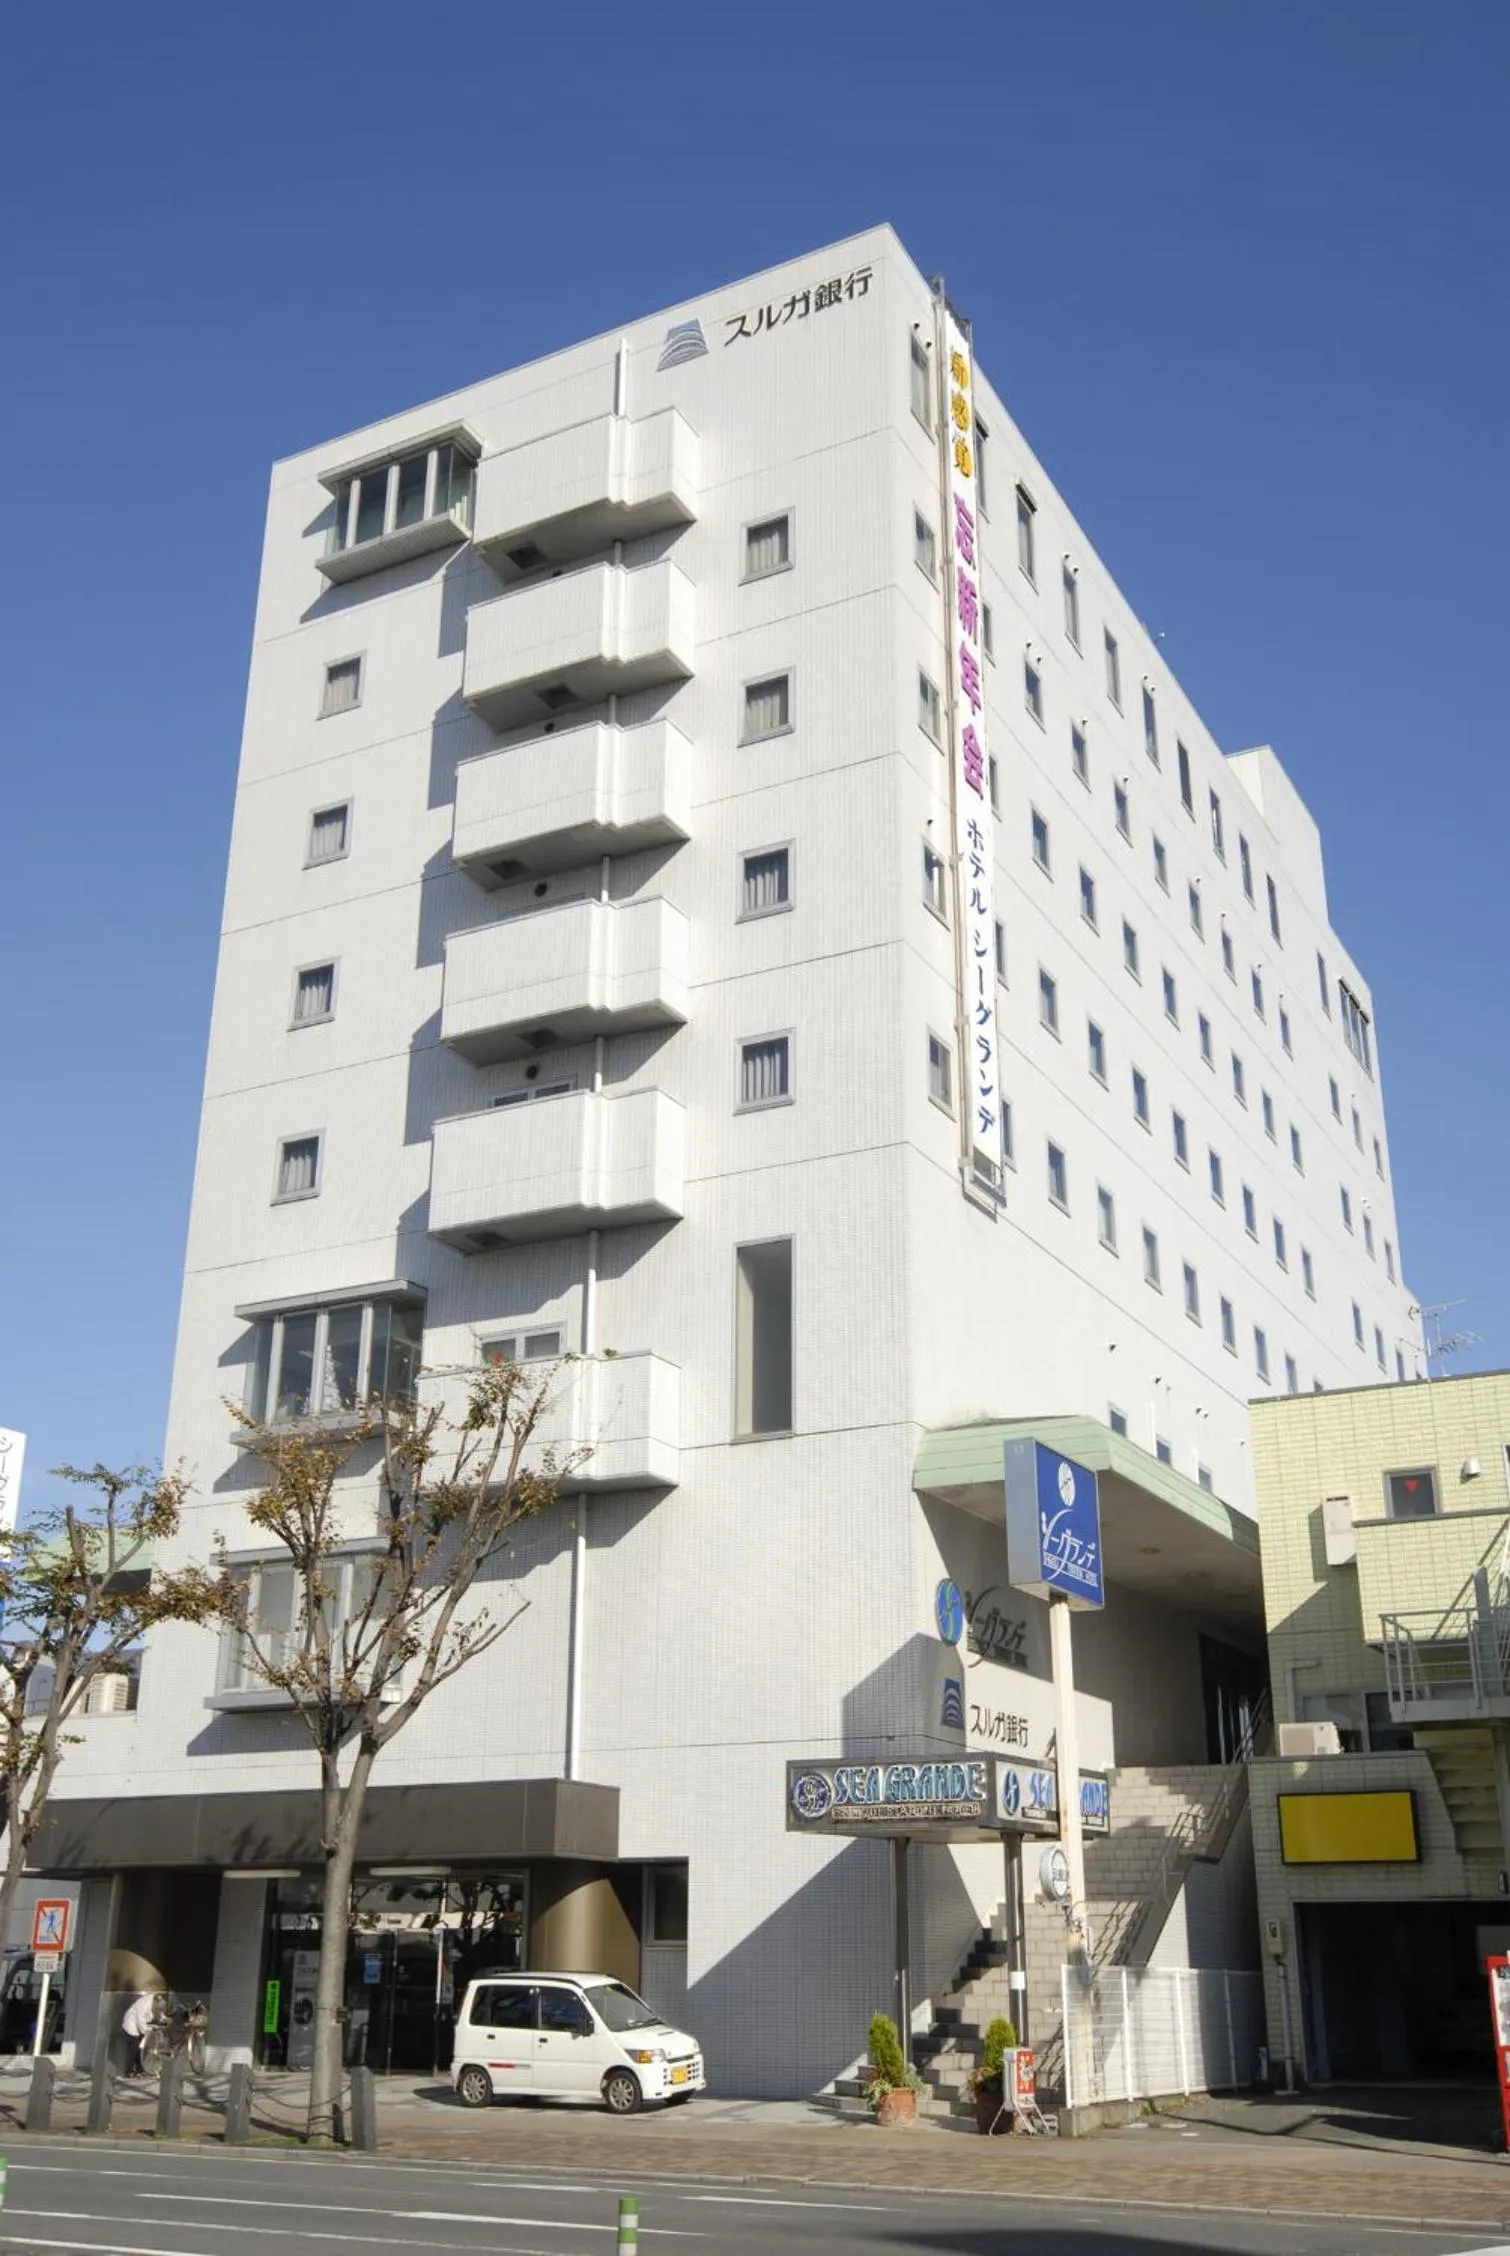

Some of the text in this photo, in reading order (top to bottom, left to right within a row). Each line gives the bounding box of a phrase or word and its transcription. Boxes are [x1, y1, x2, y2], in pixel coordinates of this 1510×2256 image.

[724, 266, 873, 347] スルガ銀行
[966, 818, 995, 1134] ホテルシーグランデ
[1041, 1508, 1097, 1581] シーグランデ
[970, 1704, 1030, 1749] スルガ銀行
[835, 1762, 985, 1804] SEA GRANDE
